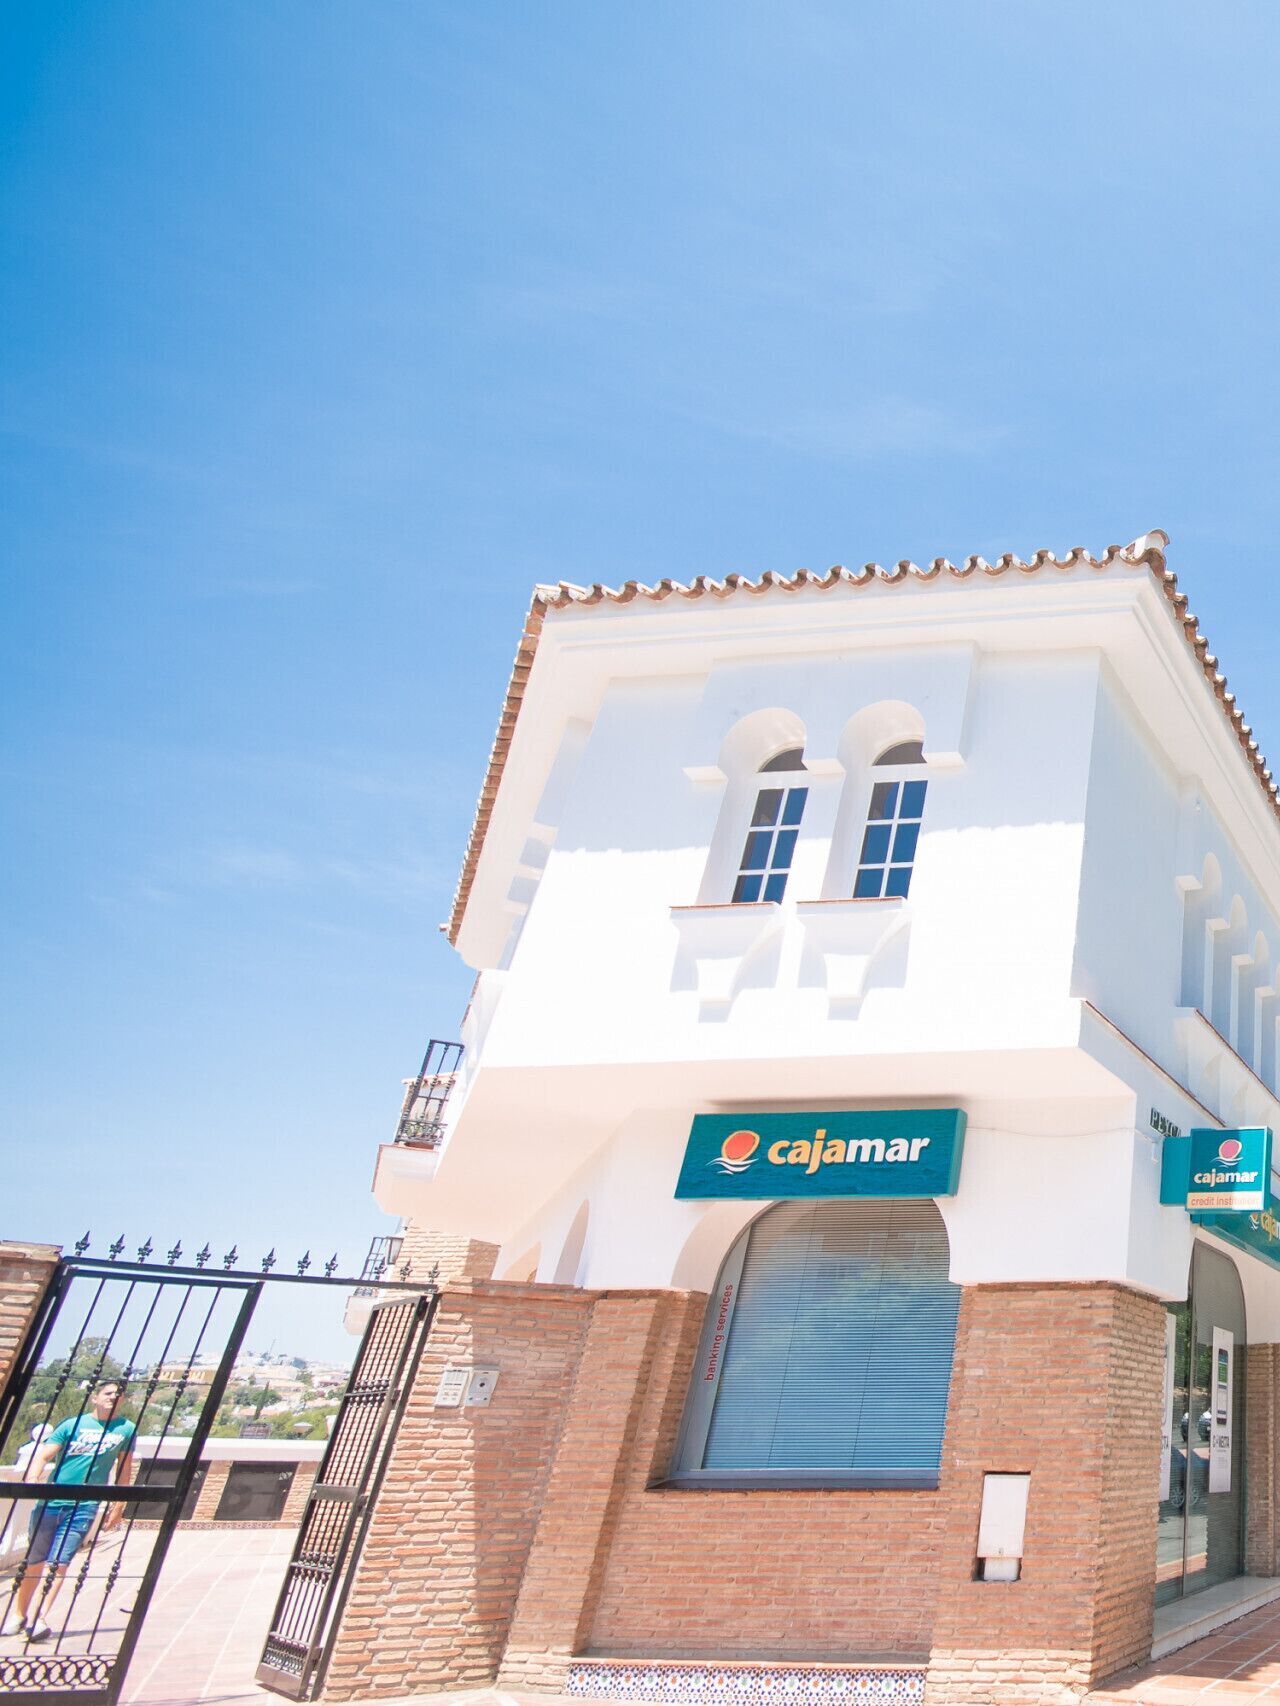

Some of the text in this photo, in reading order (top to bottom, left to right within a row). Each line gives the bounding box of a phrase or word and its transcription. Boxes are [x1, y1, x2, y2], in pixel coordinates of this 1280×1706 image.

[767, 1128, 930, 1175] cajamar
[1193, 1168, 1258, 1187] cajamar
[704, 1284, 733, 1381] banking services
